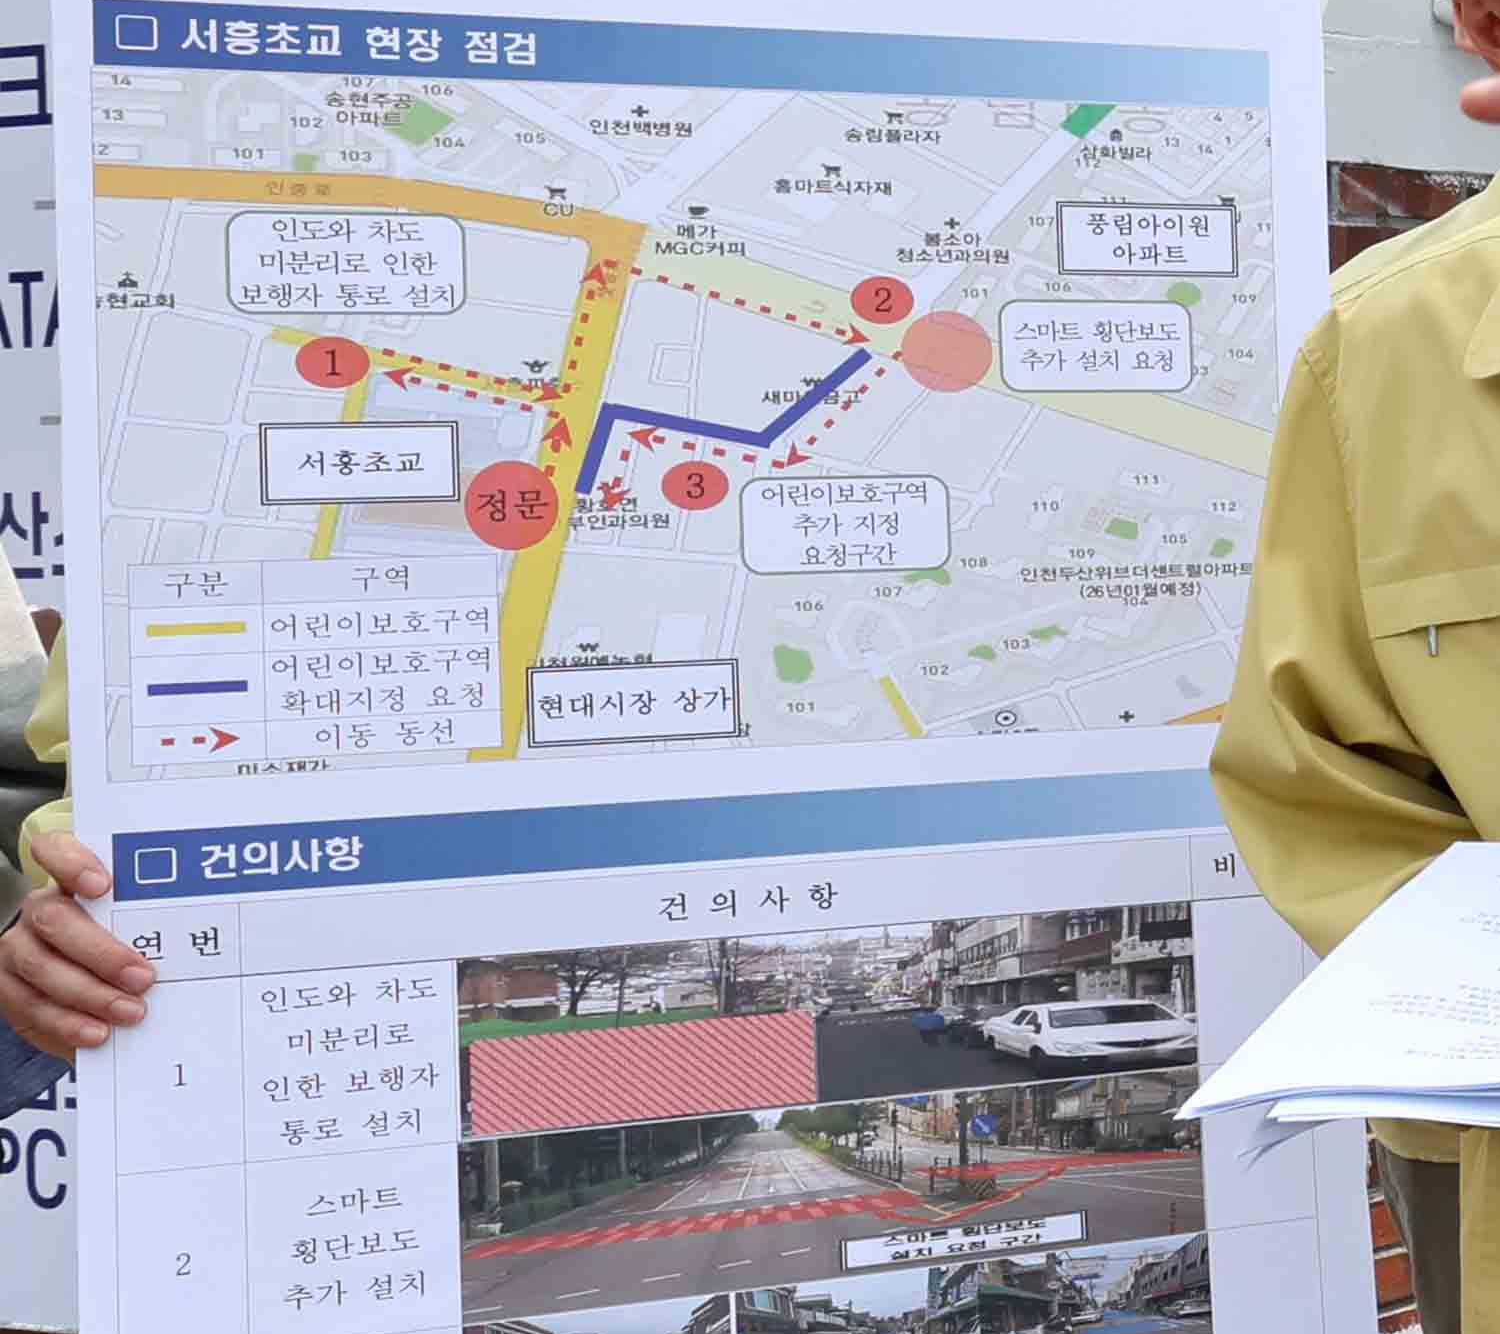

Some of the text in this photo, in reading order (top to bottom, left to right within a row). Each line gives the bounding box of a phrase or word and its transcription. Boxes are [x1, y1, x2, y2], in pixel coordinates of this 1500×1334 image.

[181, 18, 537, 67] 서흥초교 현장 점검
[290, 116, 323, 129] 102
[335, 110, 403, 126] 아파트
[589, 119, 693, 138] 인천백병원
[232, 148, 265, 160] 101
[542, 203, 574, 218] CU
[271, 218, 425, 244] 인도와 차도
[676, 223, 718, 241] 메가
[1086, 213, 1211, 238] 풍림아이원
[655, 240, 747, 258] MGC커피
[1111, 243, 1189, 266] 아파트
[258, 250, 438, 276] 미분리로 인한
[238, 283, 456, 309] 보행자 통로 설치
[874, 288, 893, 314] 2
[1013, 321, 1182, 344] 스마트 횡단보도
[325, 349, 341, 377] 1
[1020, 349, 1176, 373] 추가 설치 요청
[686, 472, 706, 499] 3
[760, 481, 929, 509] 어린이보호구역
[476, 488, 549, 522] 정문
[793, 514, 900, 538] 추가 지정
[799, 543, 896, 568] 요청구간
[163, 571, 229, 599] 구분
[352, 565, 411, 593] 구역
[271, 606, 490, 641] 어린이보호구역
[271, 646, 491, 682] 어린이보호구역
[281, 682, 486, 716] 확대지정 요청
[537, 685, 733, 720] 현대시장 상가
[315, 718, 456, 751] 이동 동선
[200, 835, 364, 881] 건의사항
[189, 926, 223, 958] 번
[260, 975, 438, 1014] 인도와 차도
[287, 1020, 415, 1056] 미분리로
[172, 1063, 189, 1088] 1
[262, 1061, 441, 1104] 인한 보행자
[279, 1107, 423, 1147] 통로 설치
[305, 1186, 404, 1218] 스마트
[290, 1228, 421, 1266] 횡단보도
[175, 1251, 193, 1277] 2
[282, 1269, 426, 1312] 추가 설치
